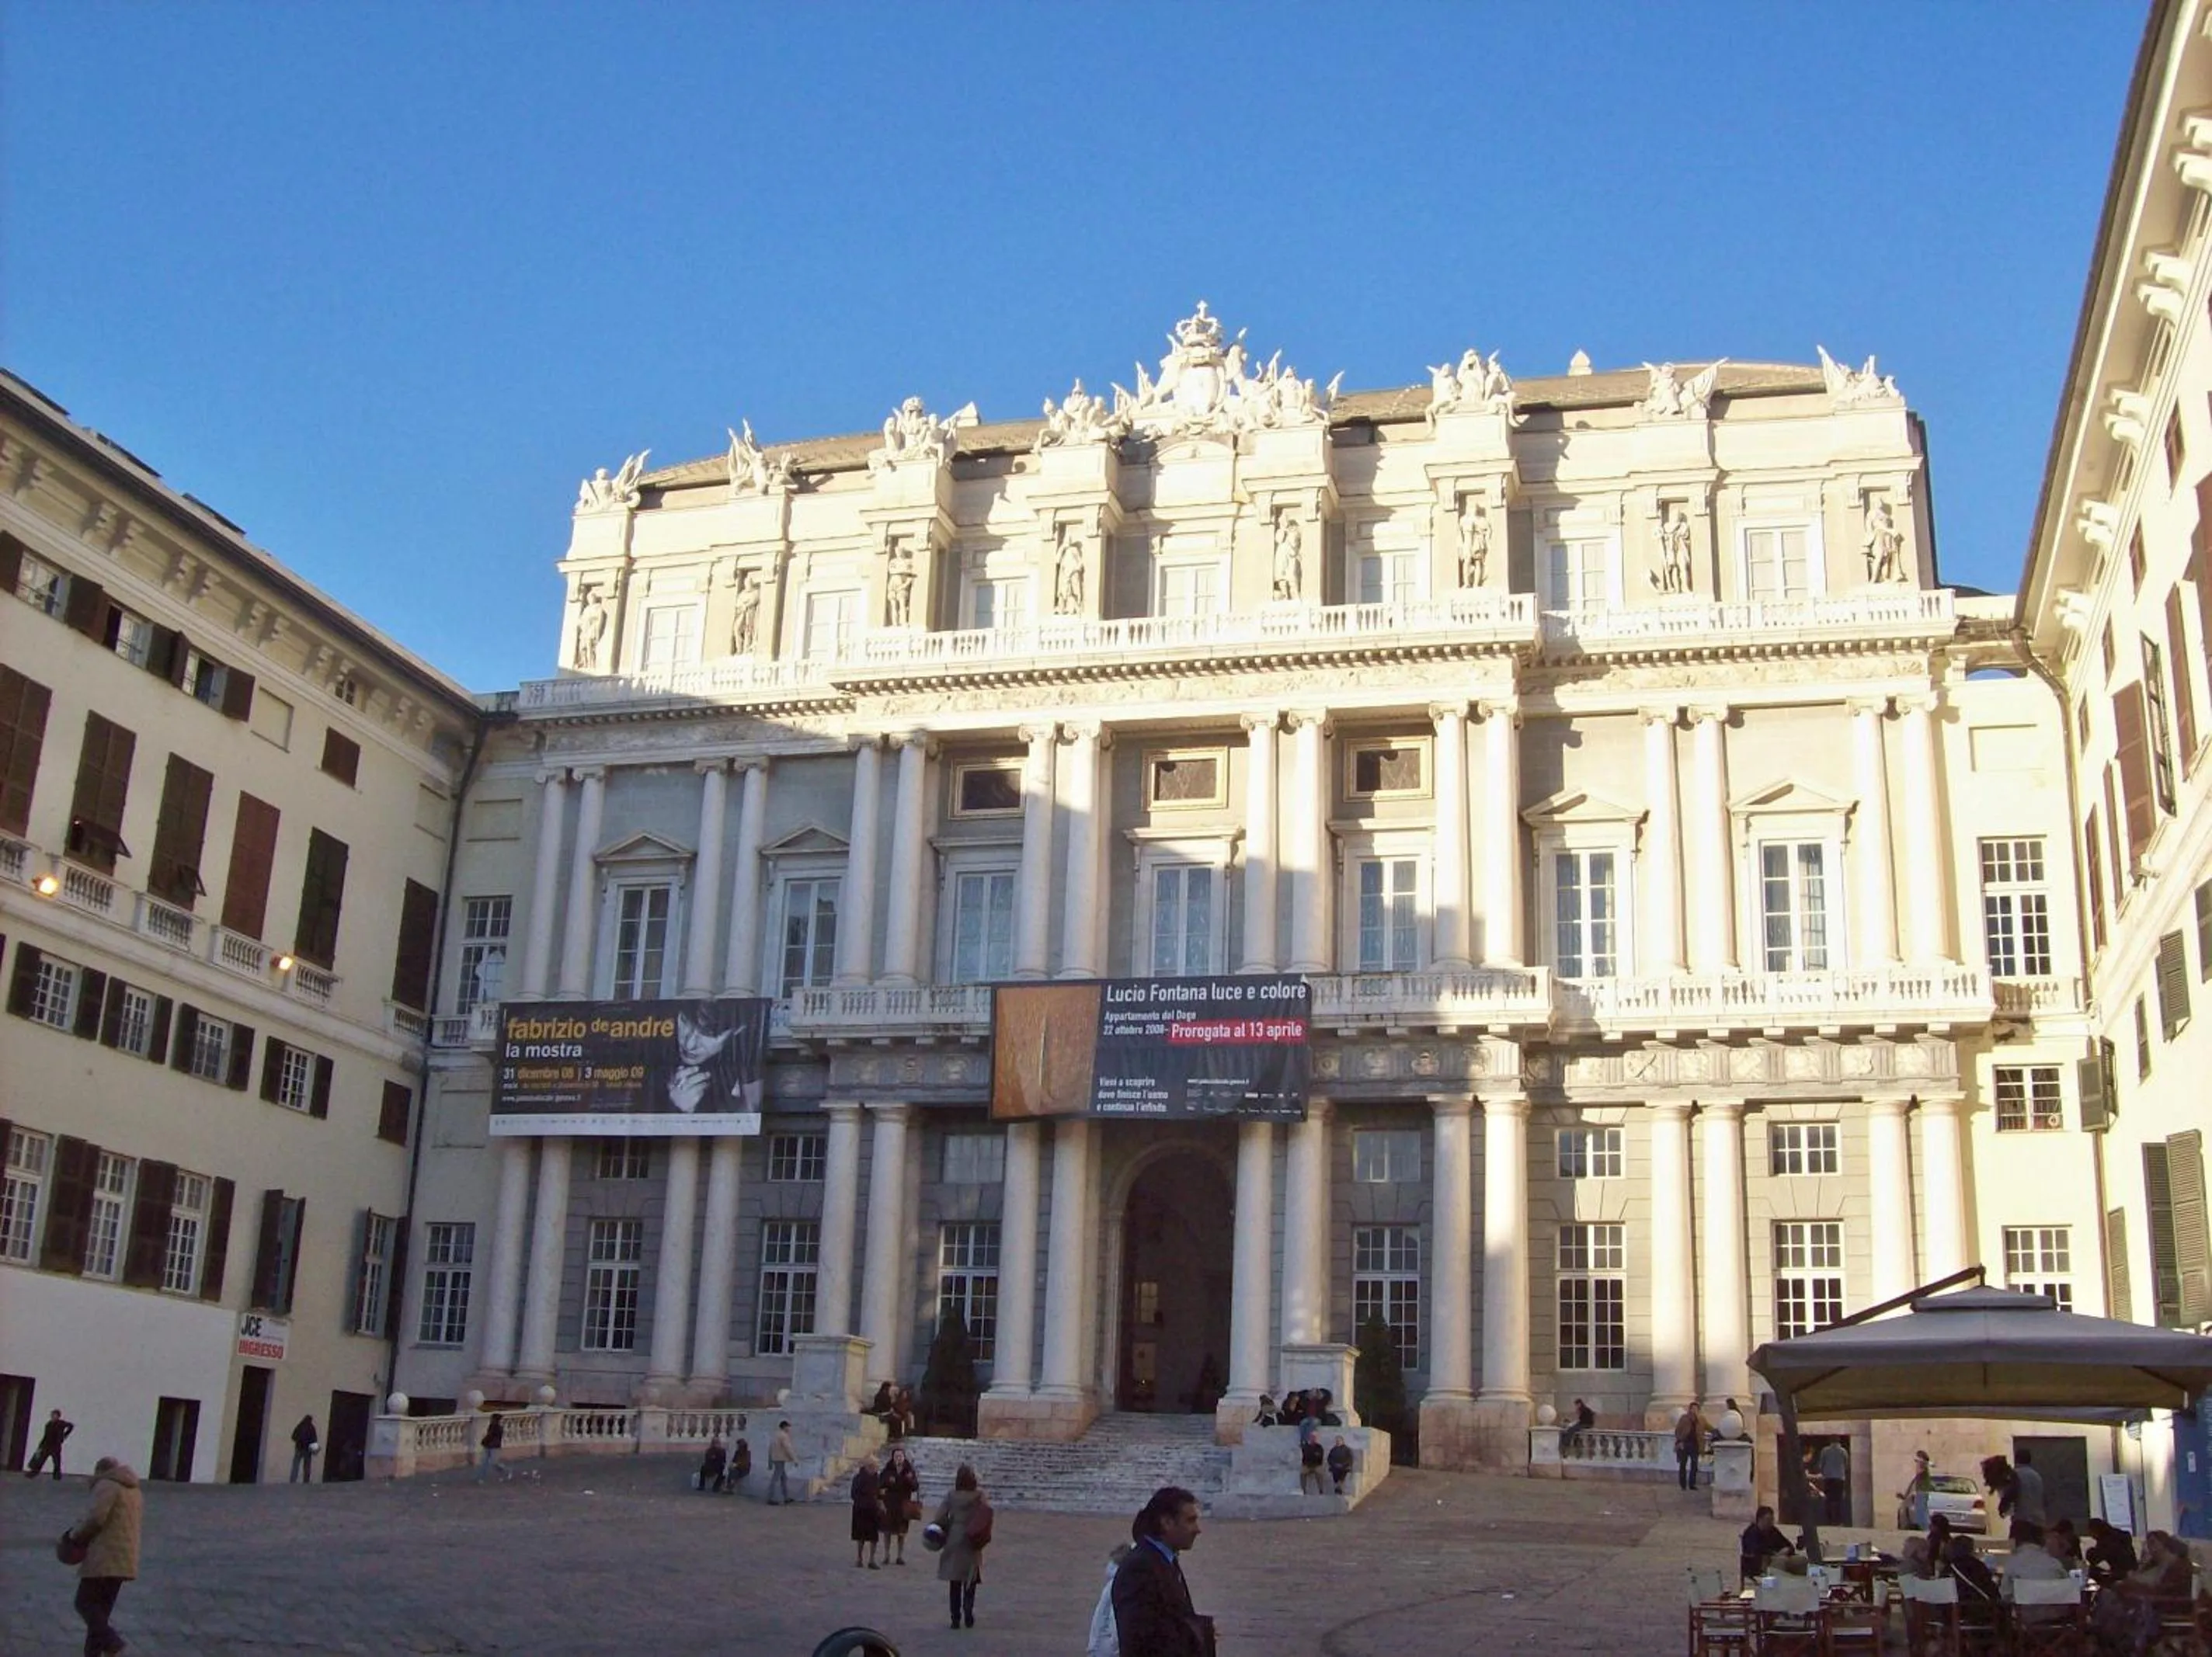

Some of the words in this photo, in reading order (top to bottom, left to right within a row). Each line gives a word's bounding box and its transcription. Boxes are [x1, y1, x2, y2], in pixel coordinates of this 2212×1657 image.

[1107, 984, 1146, 1002] Lucio
[1149, 983, 1208, 1002] Fontana
[1212, 981, 1243, 1000] luce
[1247, 985, 1256, 1000] e
[1260, 980, 1306, 999] colore
[1104, 1010, 1160, 1023] Appartamento
[1161, 1009, 1174, 1021] del
[1176, 1009, 1197, 1023] Doge
[507, 1016, 587, 1040] fabrizio
[591, 1017, 609, 1033] de
[1103, 1024, 1114, 1036] 22
[1114, 1023, 1144, 1035] ottobre
[1171, 1023, 1231, 1042] Prorogata
[1233, 1021, 1246, 1037] al
[1250, 1021, 1264, 1037] 13
[1266, 1020, 1303, 1041] aprile
[505, 1041, 520, 1058] la
[525, 1041, 583, 1058] mostra
[503, 1067, 514, 1080] 31
[517, 1065, 559, 1080] dicembre
[584, 1066, 593, 1079] 3
[593, 1066, 629, 1082] maggio
[631, 1065, 644, 1079] 09
[241, 1315, 263, 1338] JCE
